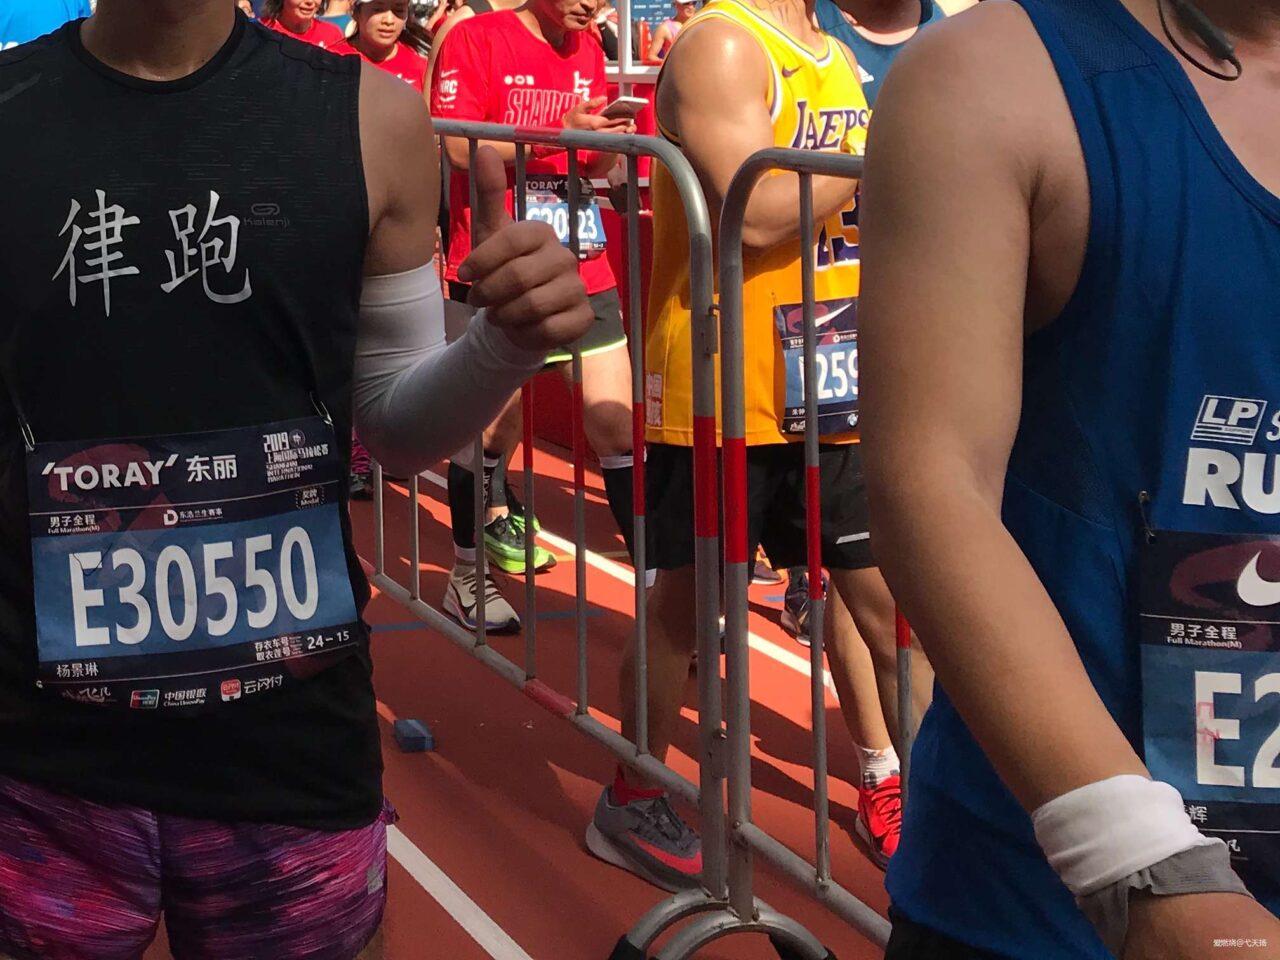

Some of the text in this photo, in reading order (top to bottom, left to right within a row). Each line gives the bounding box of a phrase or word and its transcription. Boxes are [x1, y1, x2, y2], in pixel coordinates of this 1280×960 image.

[52, 189, 252, 317] 律跑
[798, 349, 858, 401] 259
[1202, 398, 1259, 426] LP
[263, 432, 290, 453] 2019
[186, 454, 238, 483] 东丽
[49, 514, 96, 527] 男子全程
[69, 526, 319, 647] E30550
[1167, 636, 1183, 644] Full
[1170, 622, 1237, 640] 男子全程
[56, 662, 100, 678] 杨景琳
[244, 674, 283, 694] 云闪付
[164, 688, 207, 701] 中国银联
[1184, 804, 1208, 823] 辉
